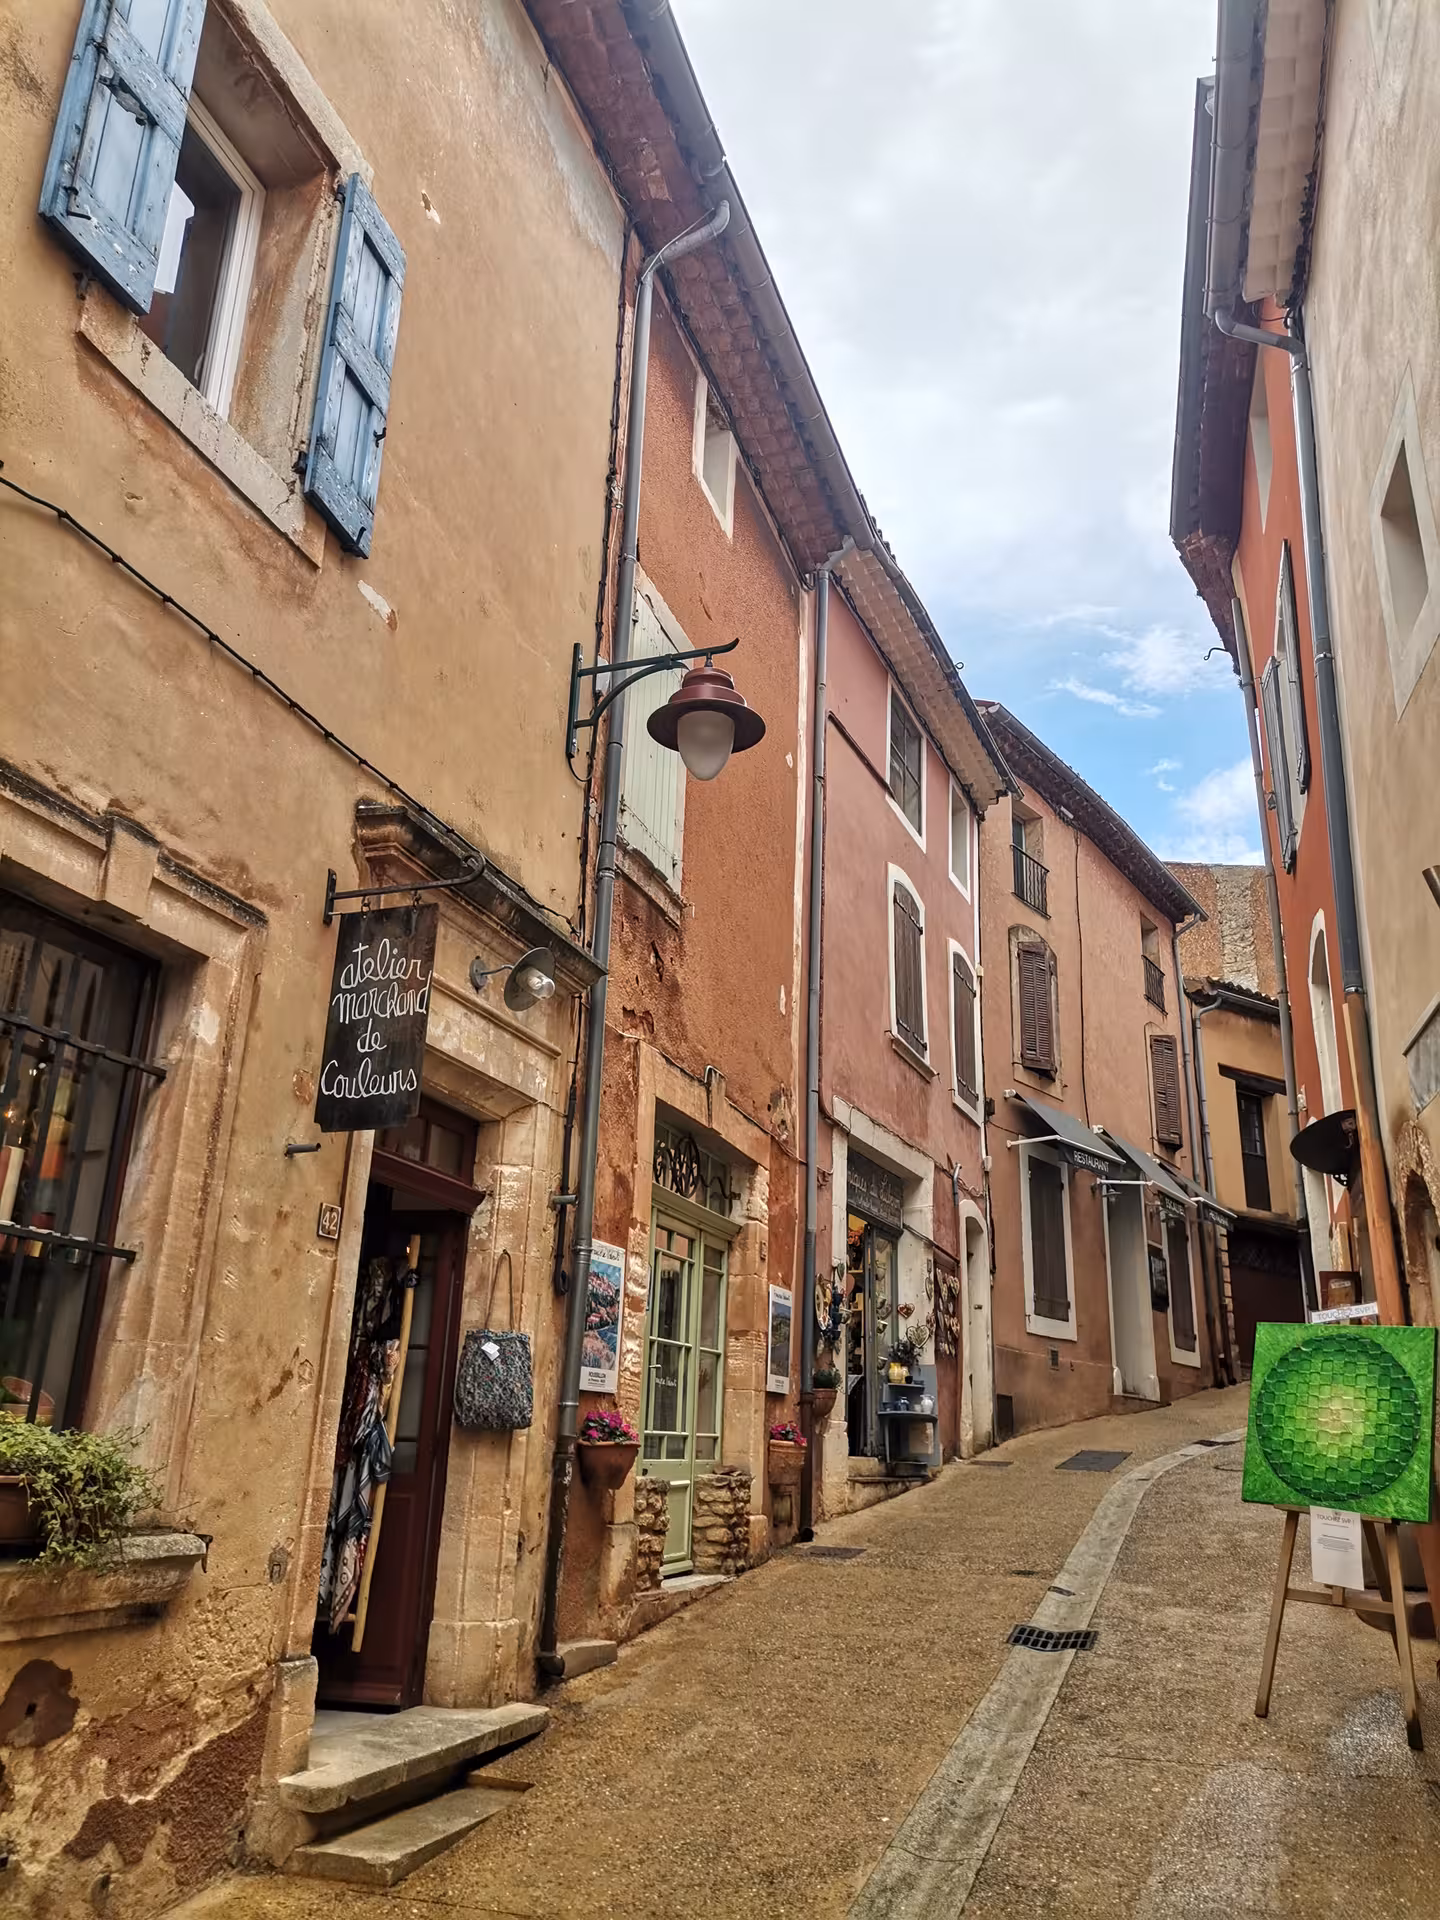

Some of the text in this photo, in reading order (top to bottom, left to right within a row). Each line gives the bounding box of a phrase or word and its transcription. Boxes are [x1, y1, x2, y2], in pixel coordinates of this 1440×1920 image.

[340, 938, 426, 989] atelier
[332, 970, 432, 1024] marchand
[357, 1018, 388, 1053] de
[320, 1057, 418, 1099] Couleurs
[1073, 1150, 1110, 1173] RESTAURANT
[322, 1211, 338, 1230] 42
[1318, 1308, 1353, 1320] TOUCHEZ
[1355, 1306, 1370, 1315] SVP
